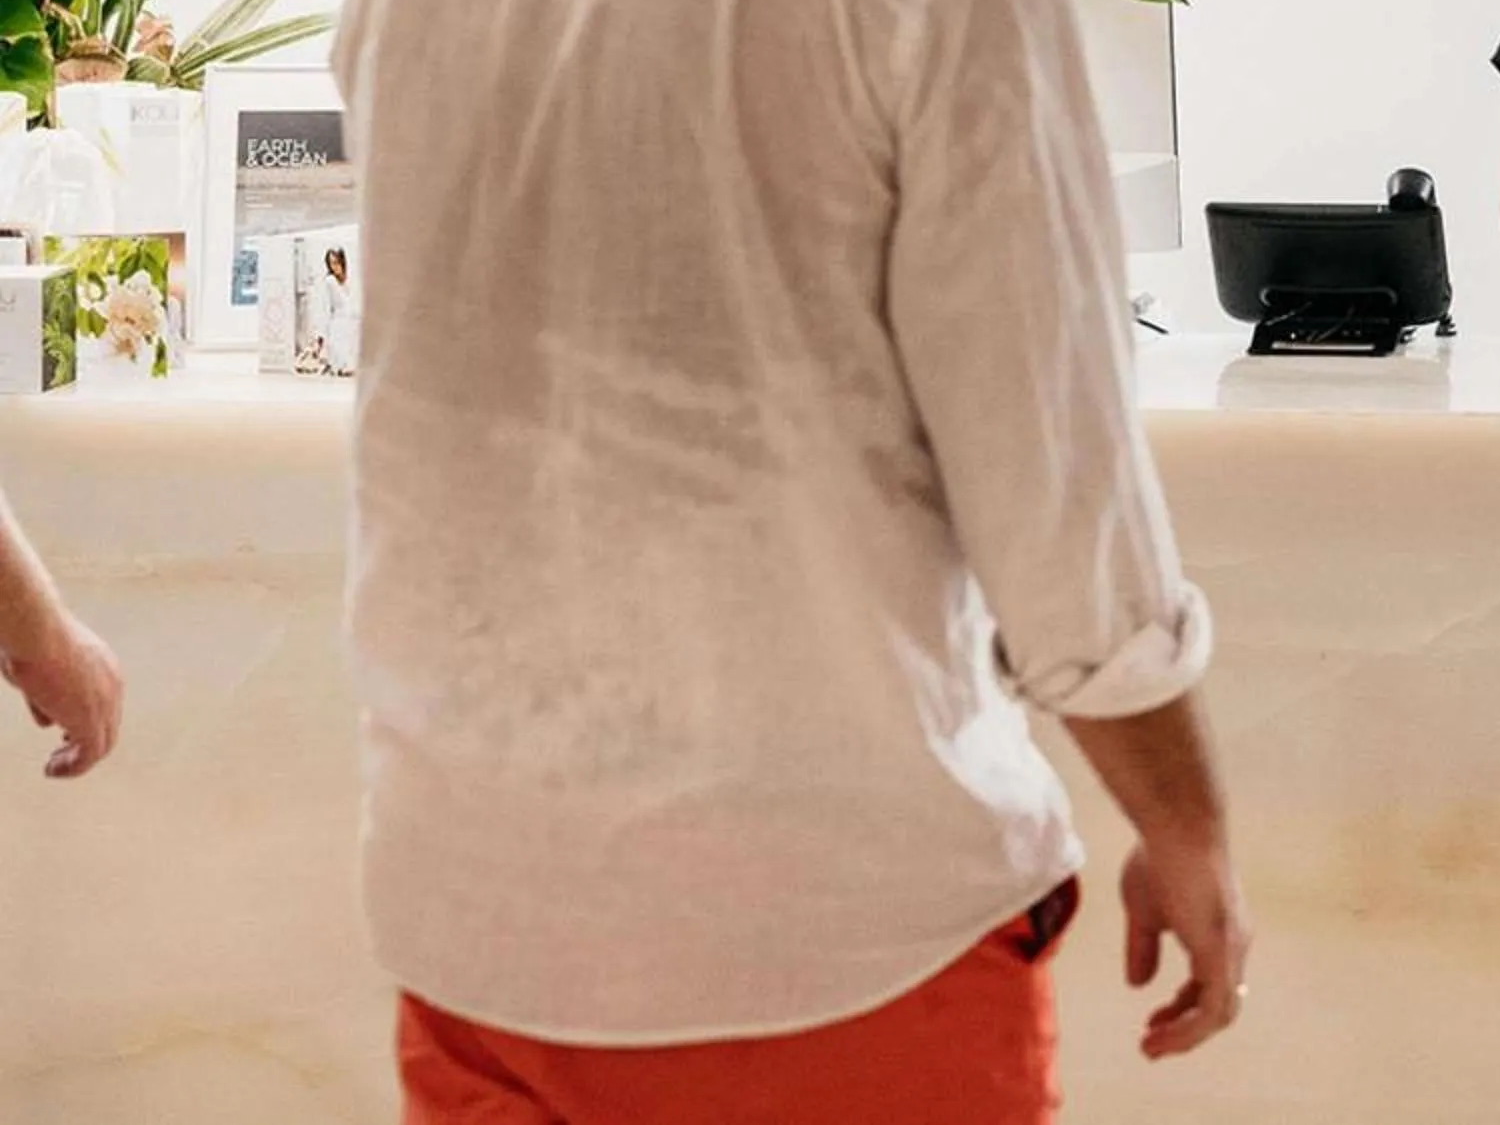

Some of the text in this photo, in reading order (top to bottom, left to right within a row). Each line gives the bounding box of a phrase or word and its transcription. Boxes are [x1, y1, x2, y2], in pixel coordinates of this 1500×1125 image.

[247, 138, 309, 153] EARTH
[245, 151, 328, 168] & OCEAN
